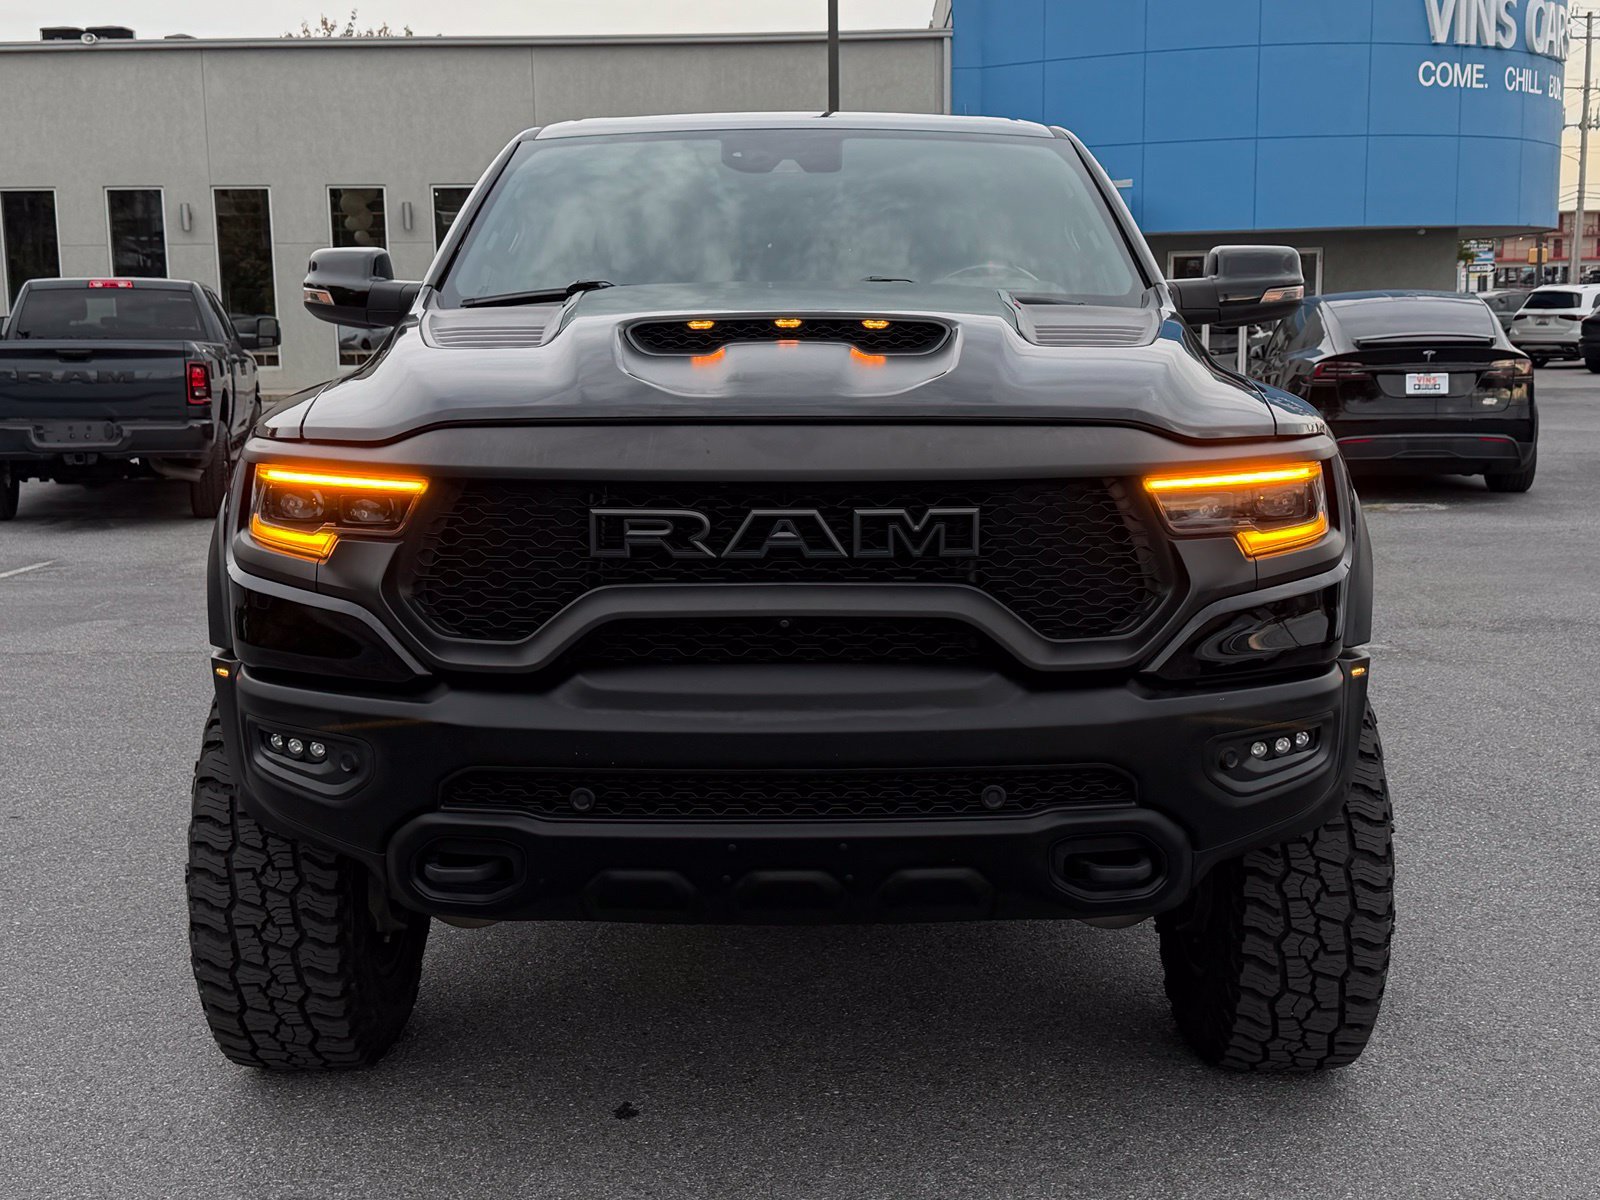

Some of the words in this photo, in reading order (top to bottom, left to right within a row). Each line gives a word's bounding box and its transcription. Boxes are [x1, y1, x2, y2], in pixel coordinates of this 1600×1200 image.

[1425, 0, 1518, 49] VINS
[1418, 61, 1488, 89] COME.
[17, 370, 135, 384] RAM
[1416, 376, 1439, 384] VINS
[589, 508, 980, 558] RAM
